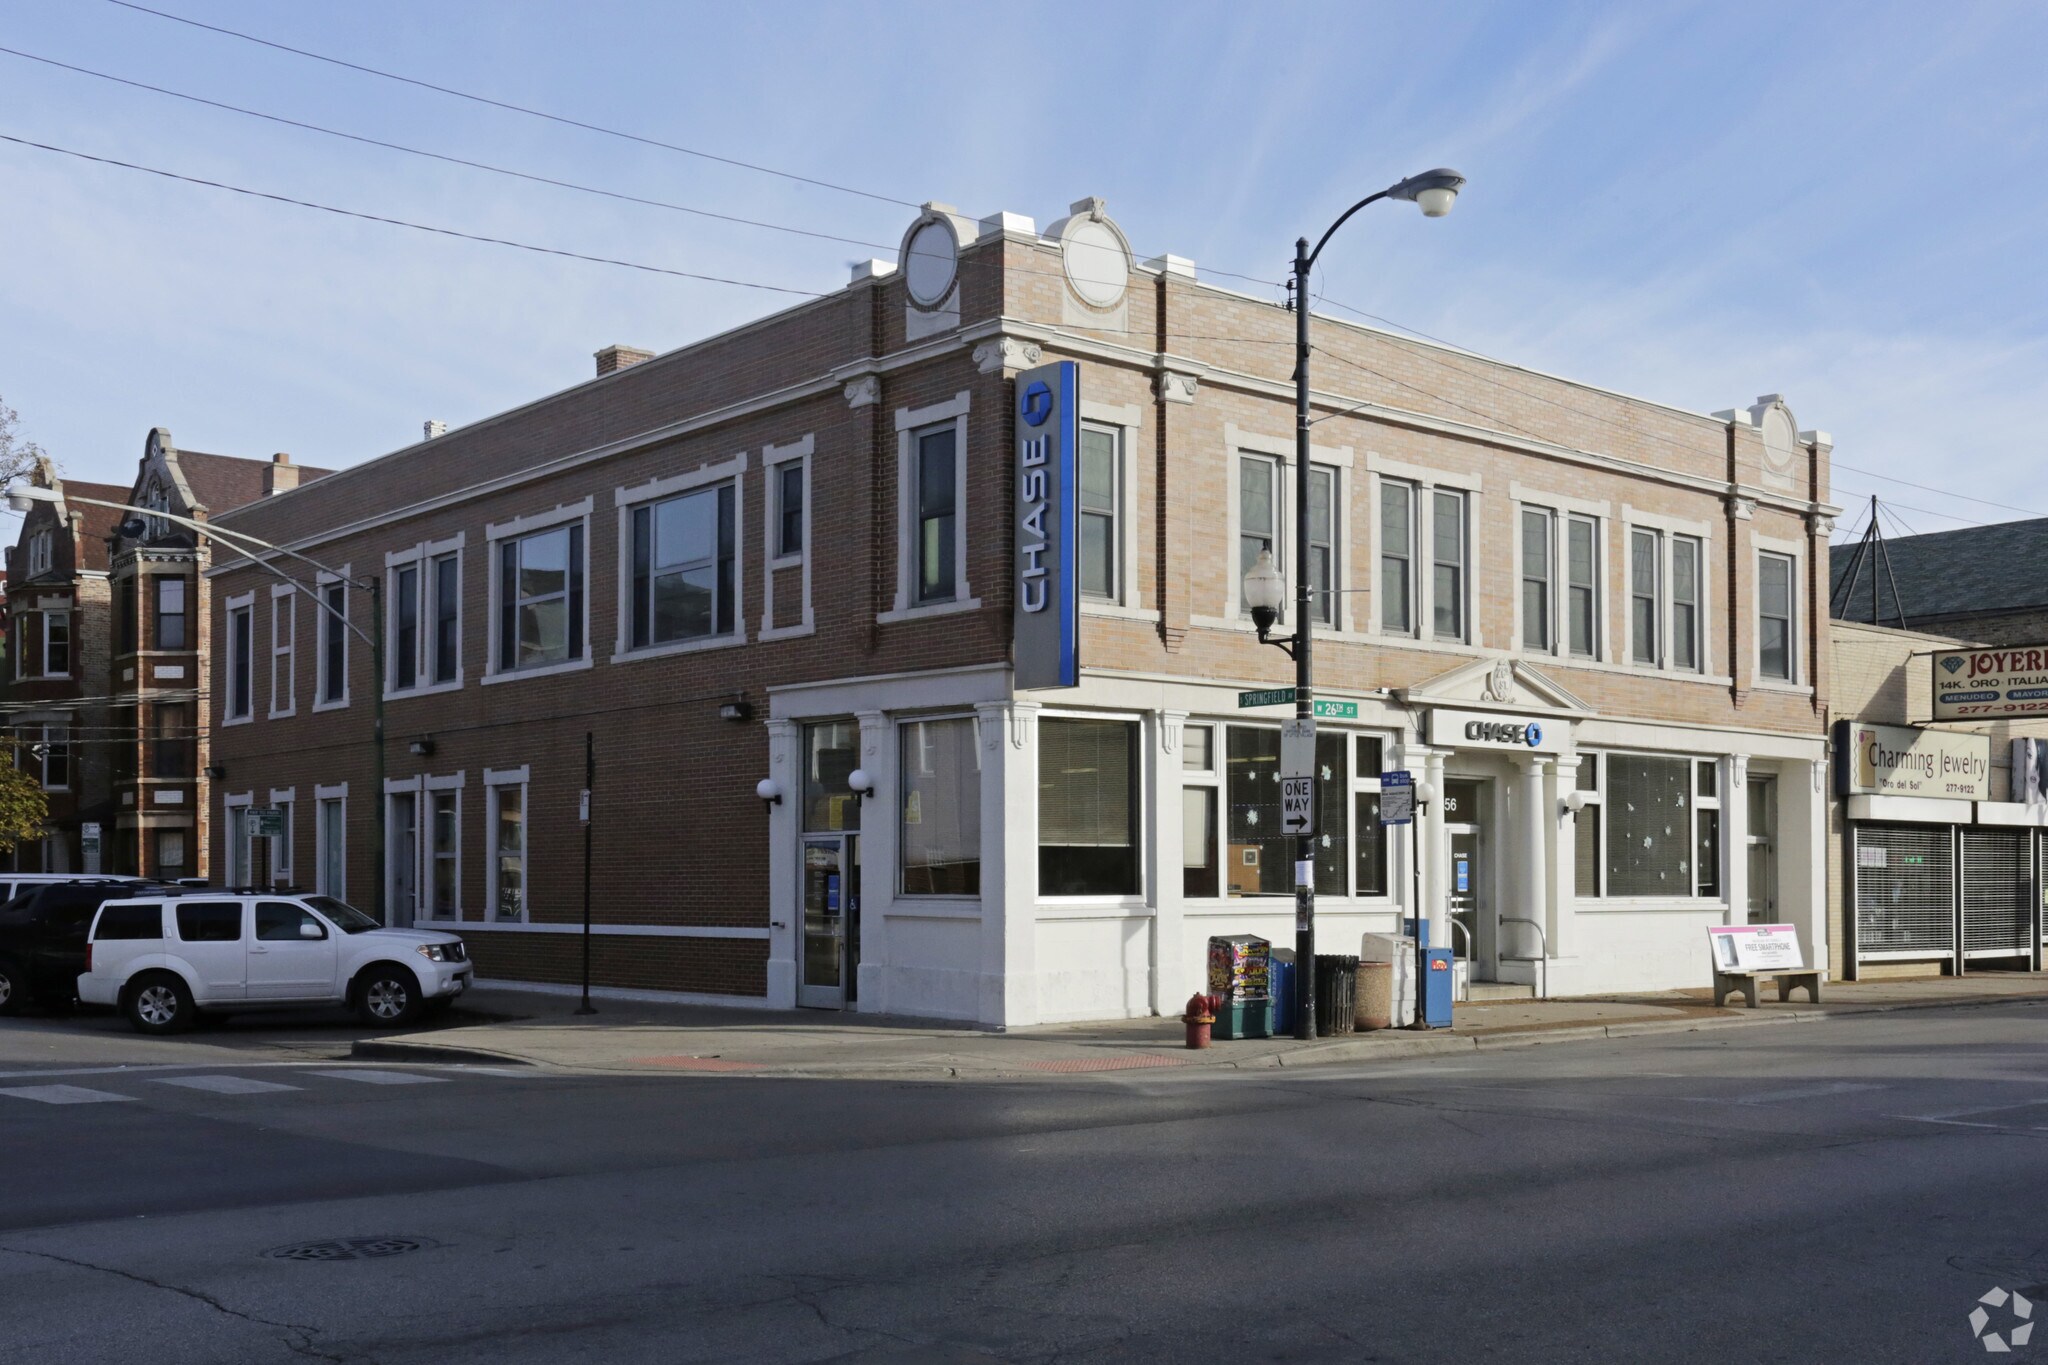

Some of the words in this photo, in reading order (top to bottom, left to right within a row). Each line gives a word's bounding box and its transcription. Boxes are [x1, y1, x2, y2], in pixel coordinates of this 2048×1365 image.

[1022, 433, 1048, 613] CHASE
[1939, 681, 1965, 689] 14K.
[1970, 679, 2000, 688] ORO
[2007, 676, 2048, 686] ITALIA
[1244, 690, 1286, 706] SPRINGFIELD
[1945, 692, 1994, 701] MENUDEO
[2012, 690, 2048, 698] MAYOR
[1325, 703, 1343, 715] 26TH
[1346, 706, 1354, 714] ST
[1958, 702, 2048, 714] 277-9122
[1465, 720, 1525, 743] CHASE
[1868, 742, 1934, 779] Charming
[1940, 749, 1986, 782] Jewelry
[1285, 782, 1309, 795] ONE
[1897, 780, 1906, 789] del
[1285, 798, 1309, 812] WAY
[1745, 943, 1758, 951] FREE
[1758, 942, 1791, 951] SMARTPHONE
